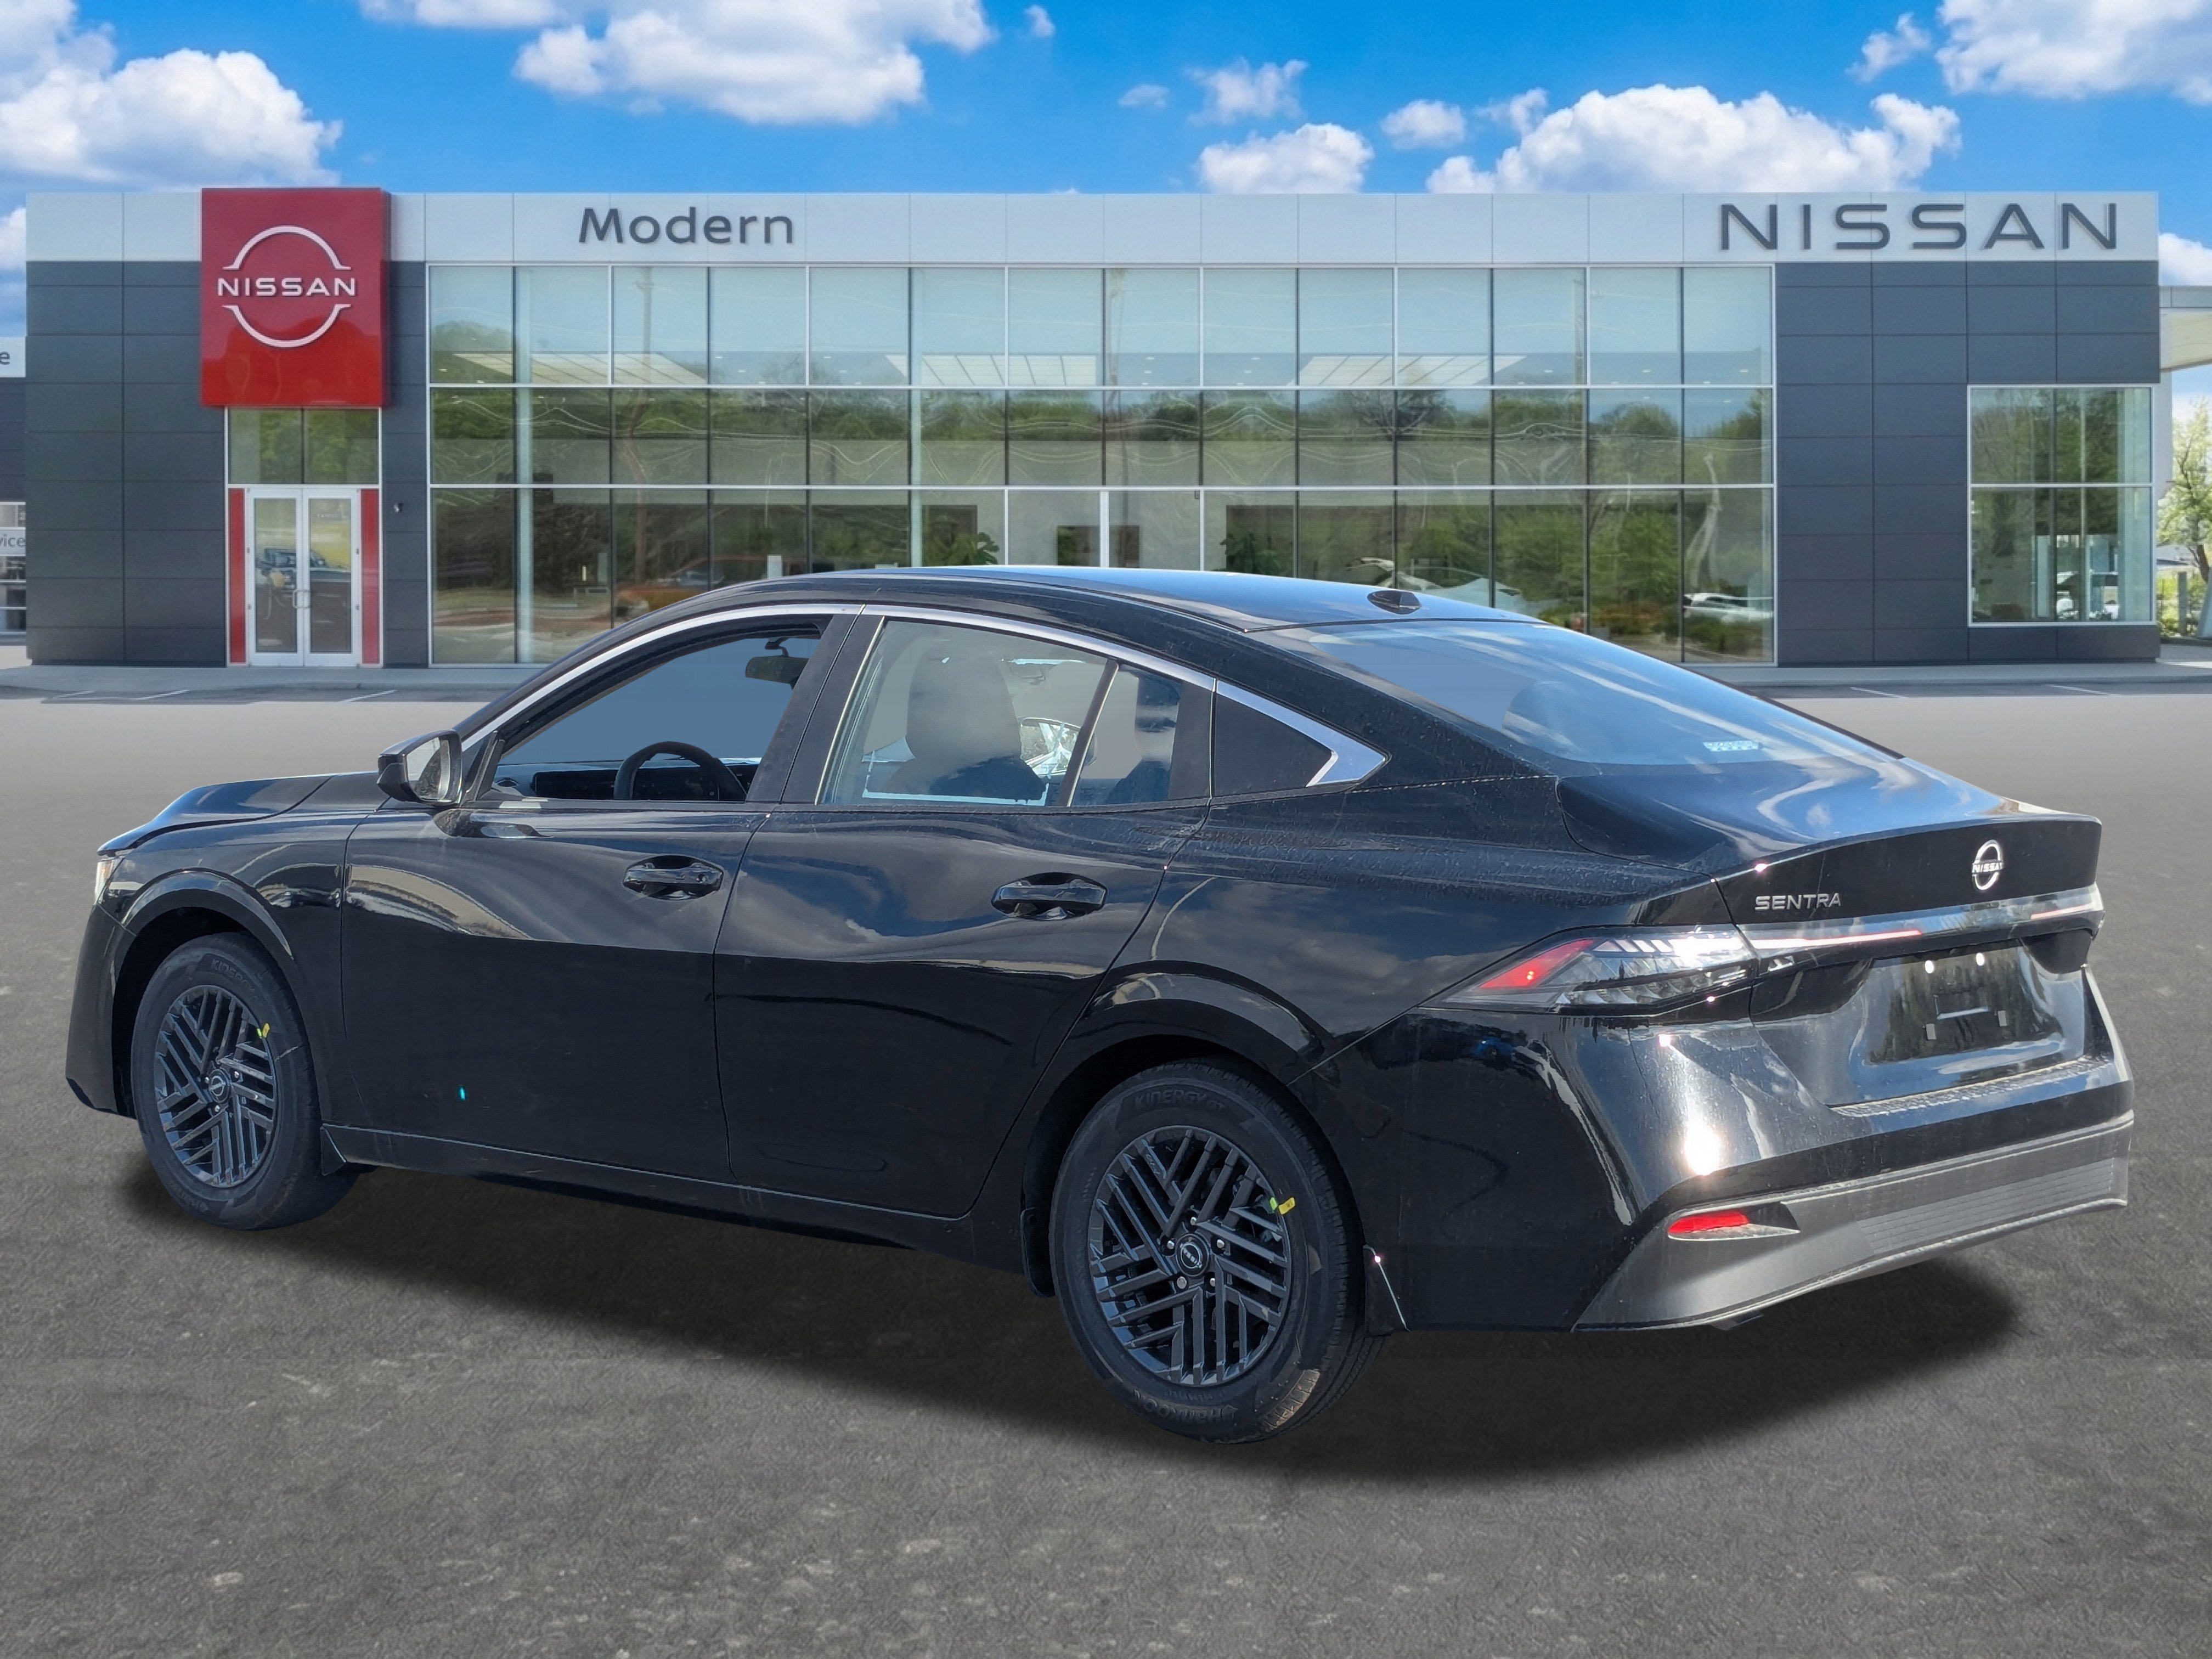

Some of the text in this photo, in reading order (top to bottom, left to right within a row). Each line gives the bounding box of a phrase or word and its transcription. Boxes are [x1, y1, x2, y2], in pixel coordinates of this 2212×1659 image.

[579, 206, 793, 244] Modern
[1720, 202, 2117, 251] NISSAN
[218, 278, 356, 296] NISSAN
[1754, 893, 1841, 911] SENTRA
